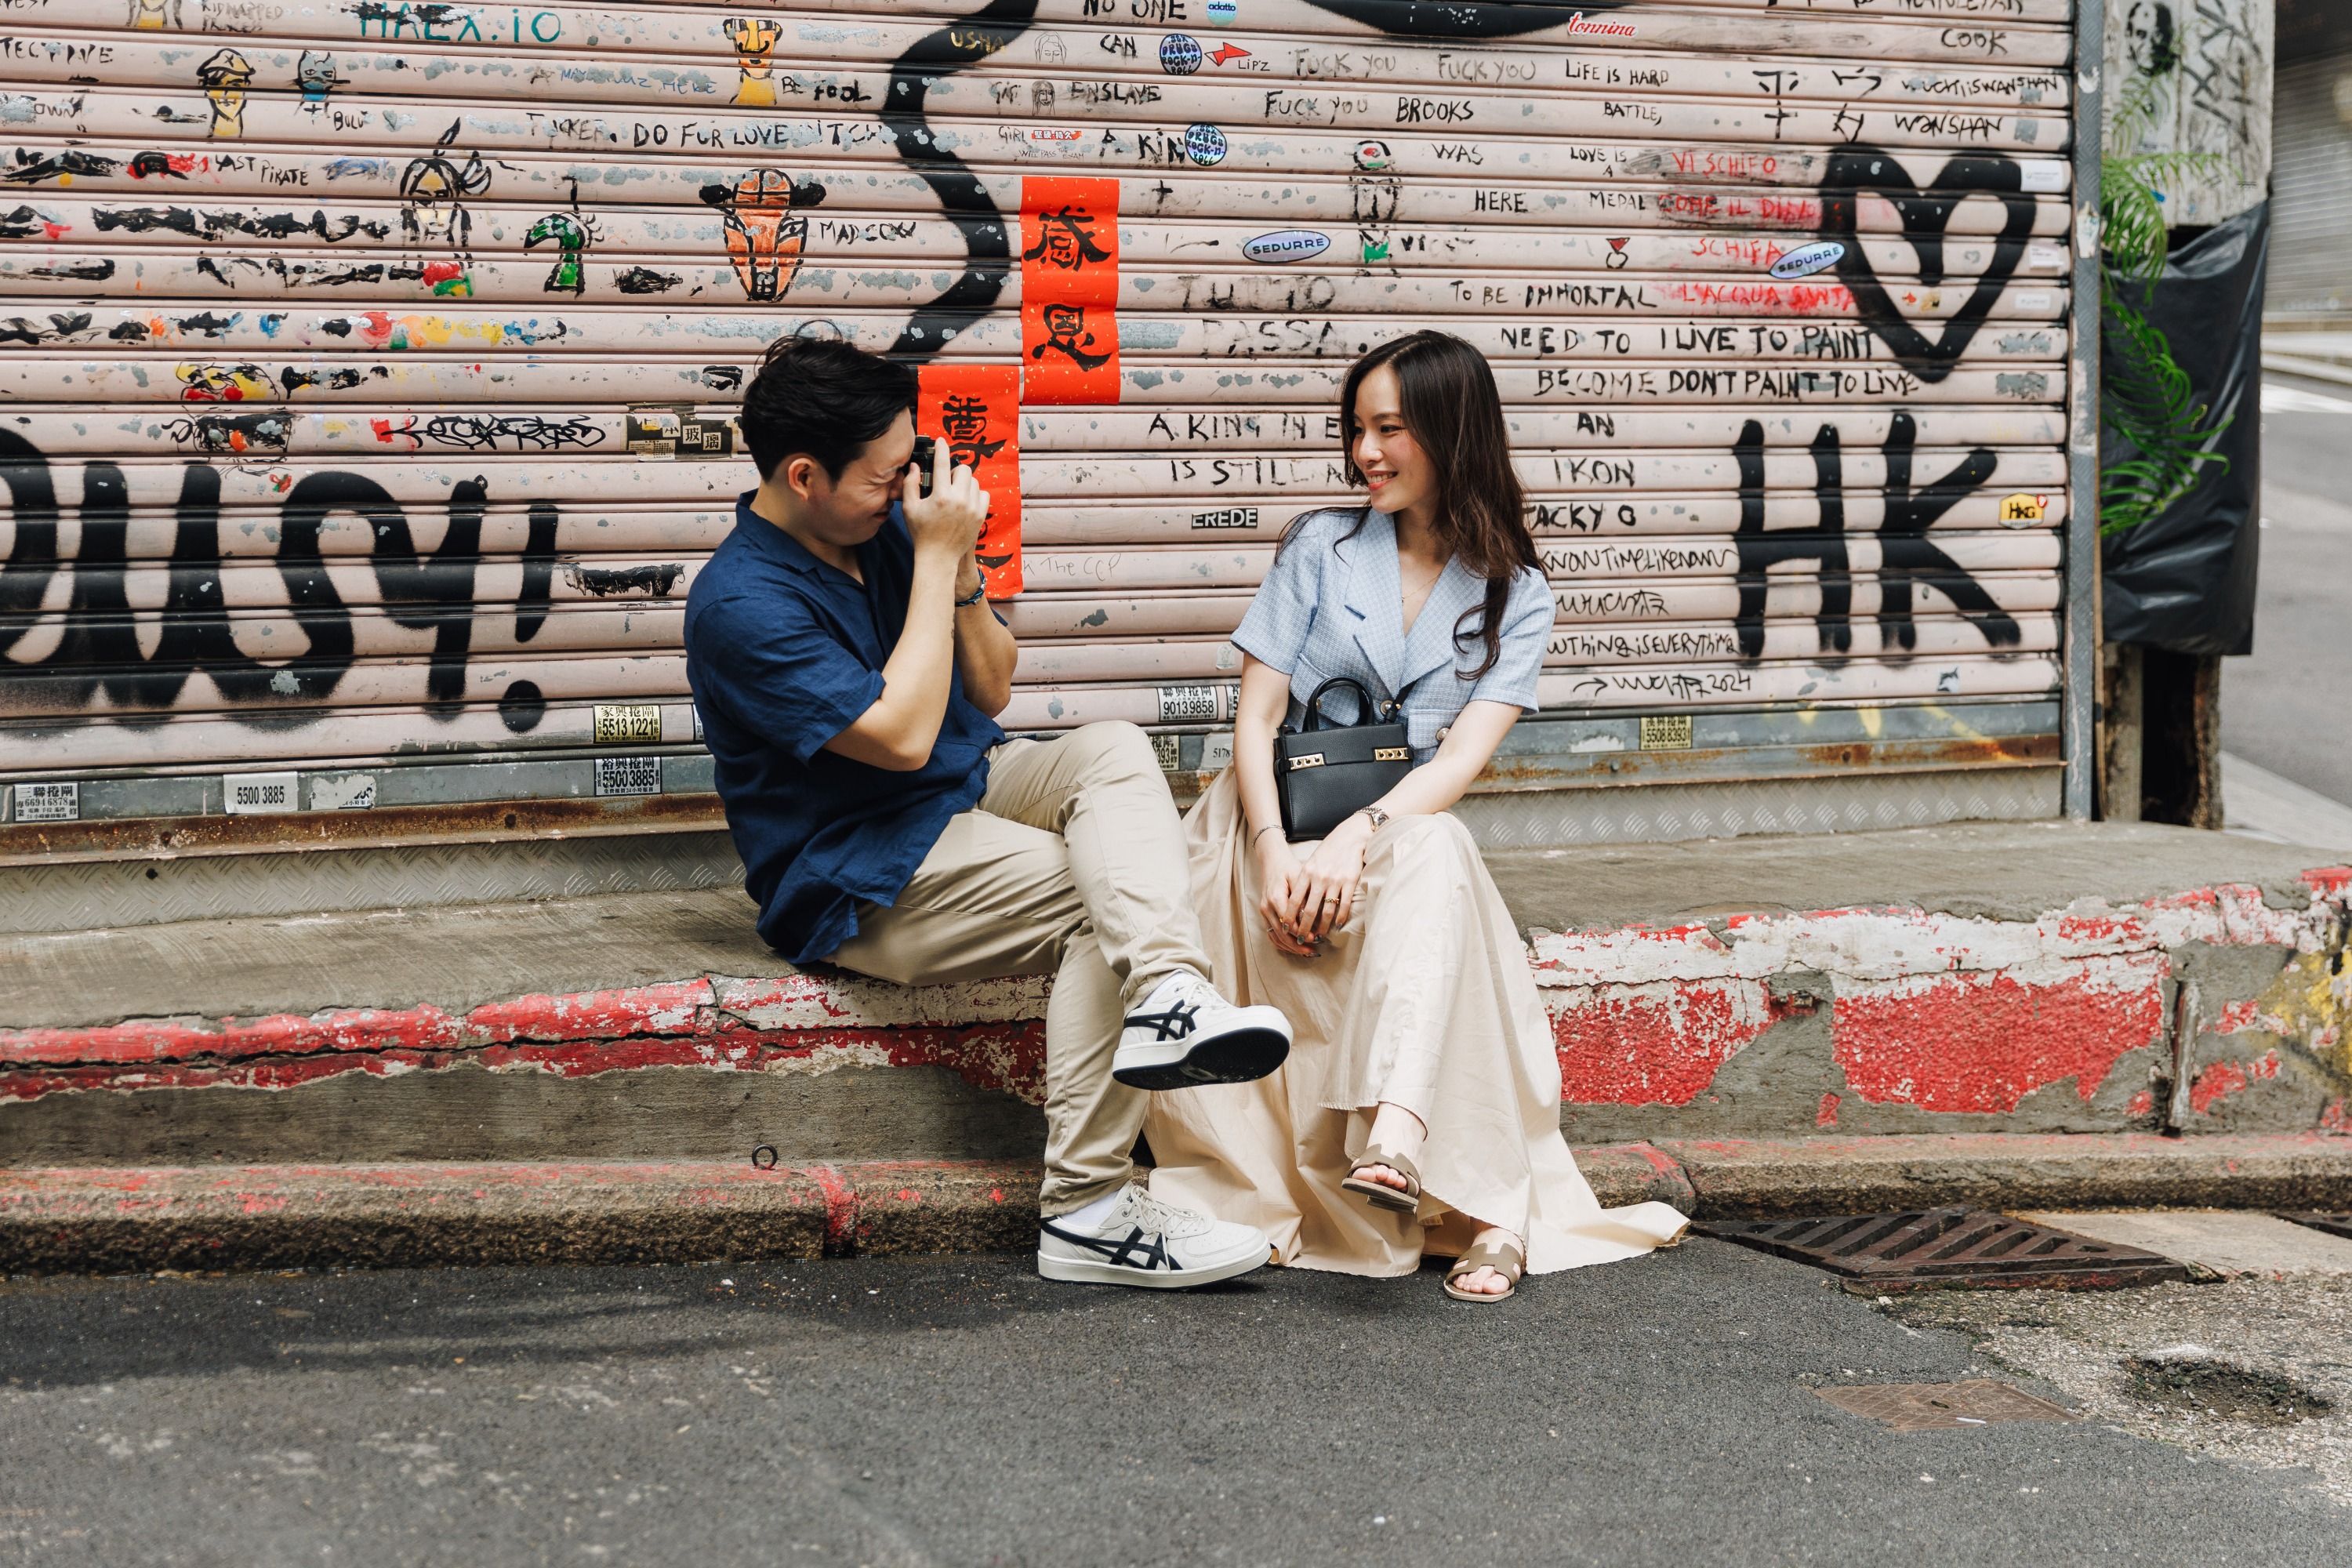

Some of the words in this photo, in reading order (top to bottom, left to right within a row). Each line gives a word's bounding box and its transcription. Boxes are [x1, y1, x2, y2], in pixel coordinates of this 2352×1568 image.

[1131, 0, 1188, 23] ONE
[1208, 3, 1236, 13] adatto
[1569, 13, 1638, 37] tonnina
[1100, 34, 1138, 60] CAN
[1162, 43, 1198, 56] DRUGS
[1940, 28, 2007, 56] COOK
[1294, 49, 1352, 77] FUCK
[1363, 53, 1396, 78] YOU
[1438, 53, 1488, 82] FUCK
[1492, 58, 1537, 82] YOU
[1630, 69, 1669, 87] HARD
[1070, 81, 1162, 107] ENSLAVE
[1265, 90, 1322, 119] FUCK
[1329, 96, 1369, 125] YOU
[1396, 96, 1475, 124] BROOKS
[633, 122, 669, 148] DO
[733, 122, 790, 146] LOVE
[215, 154, 258, 172] LAST
[1431, 143, 1485, 165] WAS
[1570, 147, 1606, 162] LOVE
[1602, 165, 1614, 178] A
[1474, 189, 1529, 214] HERE
[1252, 237, 1326, 255] SEDURRE
[1777, 245, 1841, 274] SEDURRE
[1023, 204, 1114, 372] 感恩
[1483, 285, 1509, 307] BE
[1501, 326, 1579, 354] NEED
[1597, 329, 1631, 354] TO
[1749, 327, 1788, 354] TO
[1534, 368, 1657, 398] BECOME
[1744, 370, 1820, 399] PAINT
[1833, 372, 1857, 397] TO
[1147, 412, 1175, 441] A
[1188, 414, 1261, 442] KING
[1577, 412, 1614, 438] AN
[2009, 503, 2035, 519] HKG
[1731, 407, 2023, 666] HK
[1163, 701, 1189, 715] 9013
[1189, 700, 1214, 714] 9858
[602, 717, 628, 736] 5513
[630, 717, 654, 736] 1221
[602, 770, 628, 789] 5500
[629, 769, 655, 787] 3885
[47, 797, 68, 807] 6878
[237, 786, 260, 805] 5500
[262, 786, 285, 804] 3885
